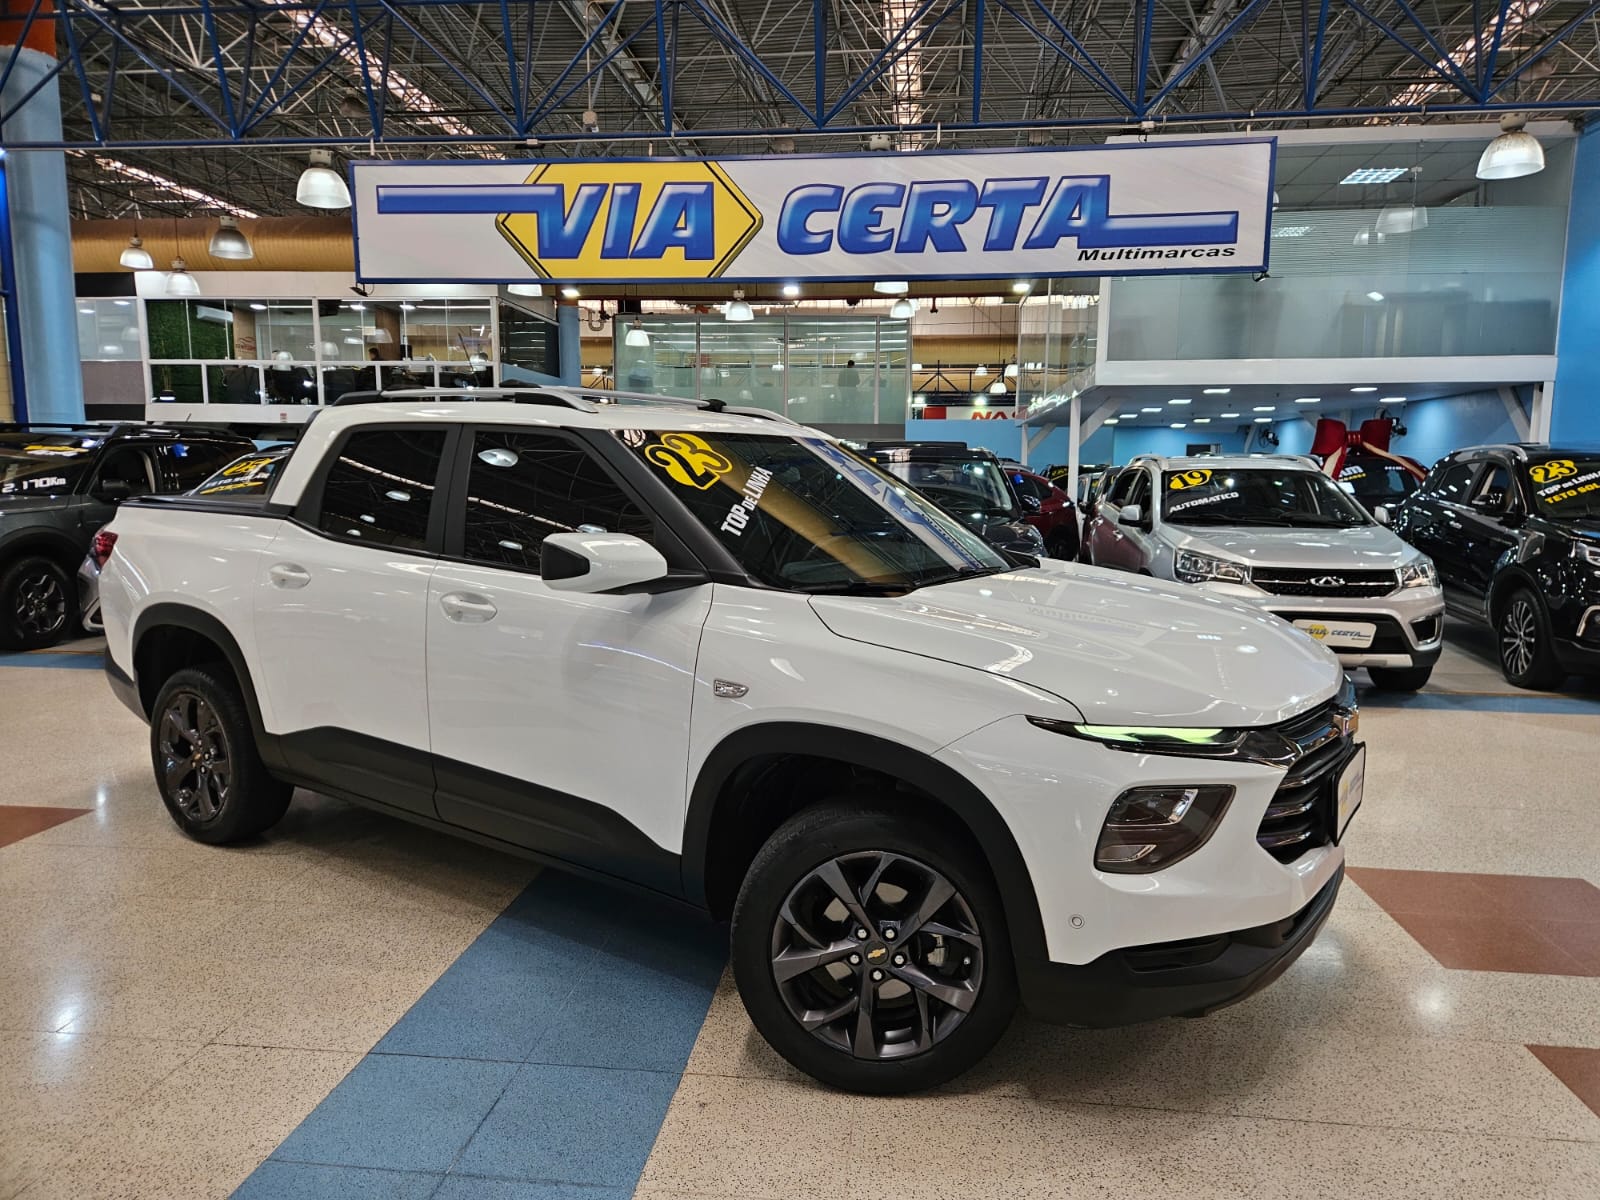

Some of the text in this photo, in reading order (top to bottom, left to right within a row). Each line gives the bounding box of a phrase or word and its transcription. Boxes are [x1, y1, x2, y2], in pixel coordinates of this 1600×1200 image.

[536, 174, 1111, 260] VIA CERTA
[1077, 247, 1237, 262] Multimarcas
[645, 433, 733, 490] 23
[1529, 460, 1578, 483] 23
[1169, 469, 1213, 489] 19
[1536, 484, 1562, 497] TOP
[1571, 470, 1600, 485] LINH
[721, 466, 774, 537] TOP DE LINHA
[1544, 489, 1577, 504] TETO
